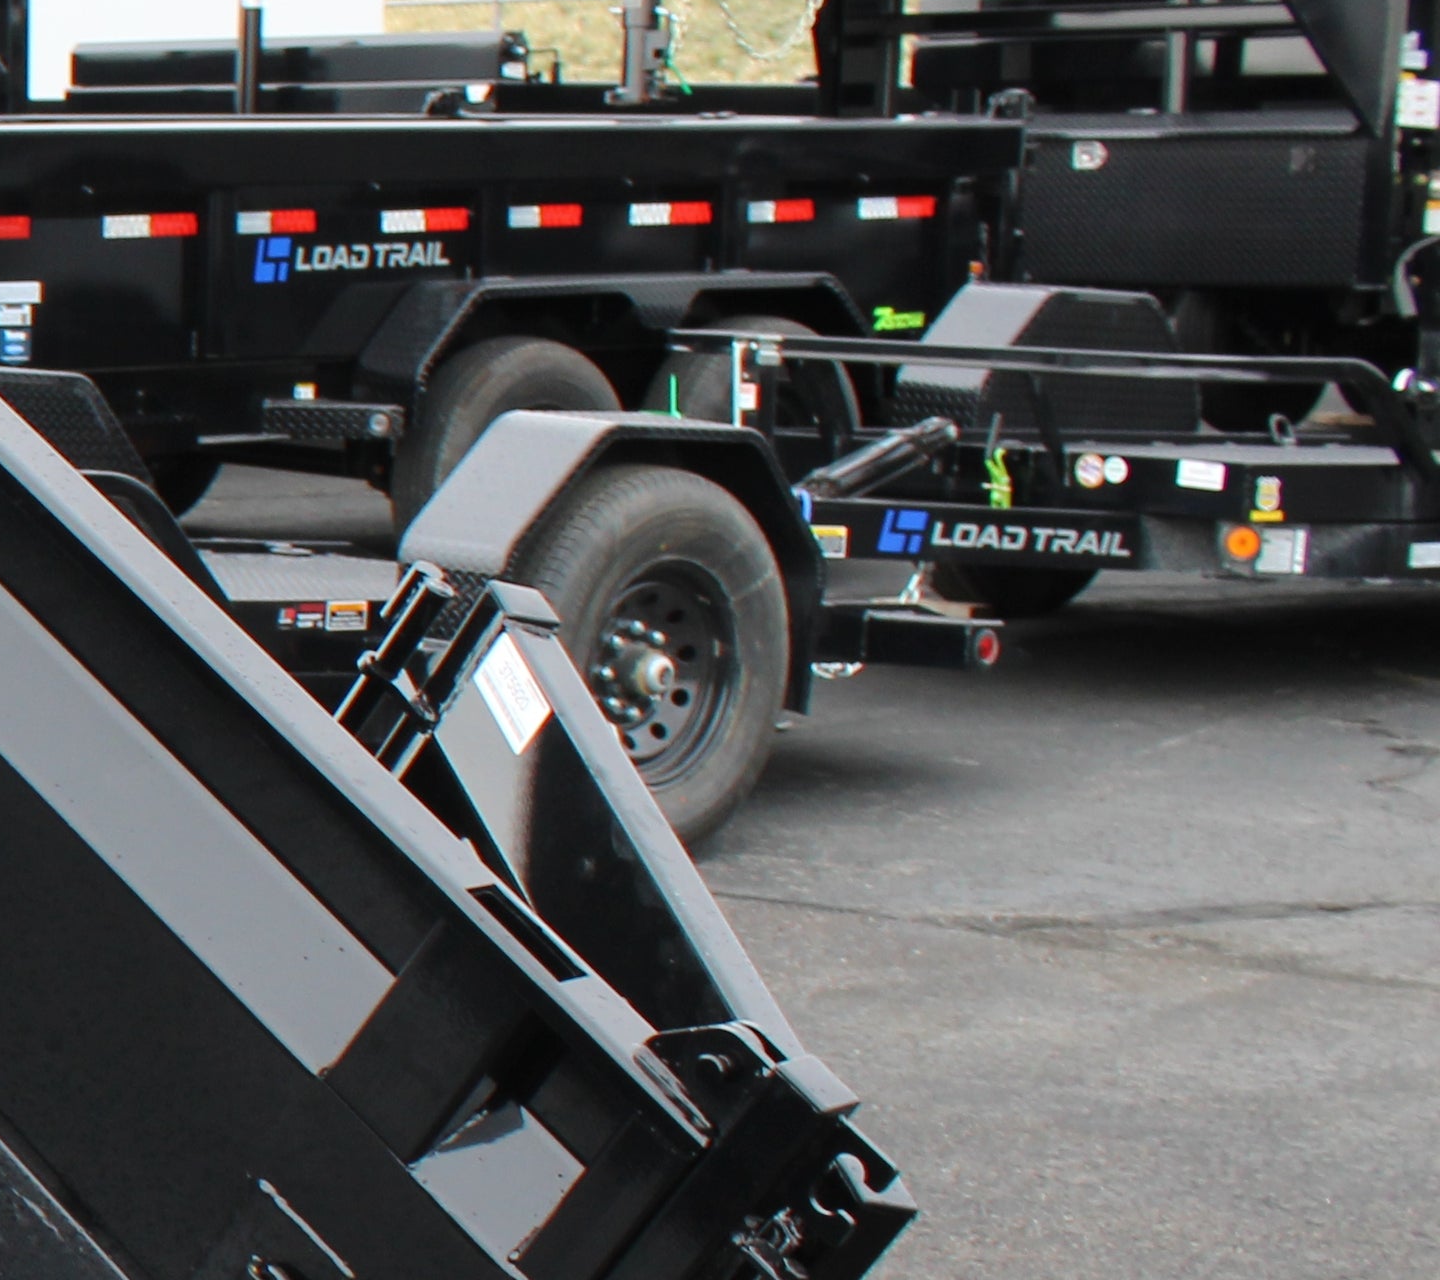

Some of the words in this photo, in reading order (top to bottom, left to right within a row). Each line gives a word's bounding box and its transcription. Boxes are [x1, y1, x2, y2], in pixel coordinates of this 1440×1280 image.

[295, 243, 370, 271] LOAD
[373, 240, 451, 268] TRAIL
[931, 521, 1028, 550] LOAD
[1031, 526, 1131, 558] TRAIL
